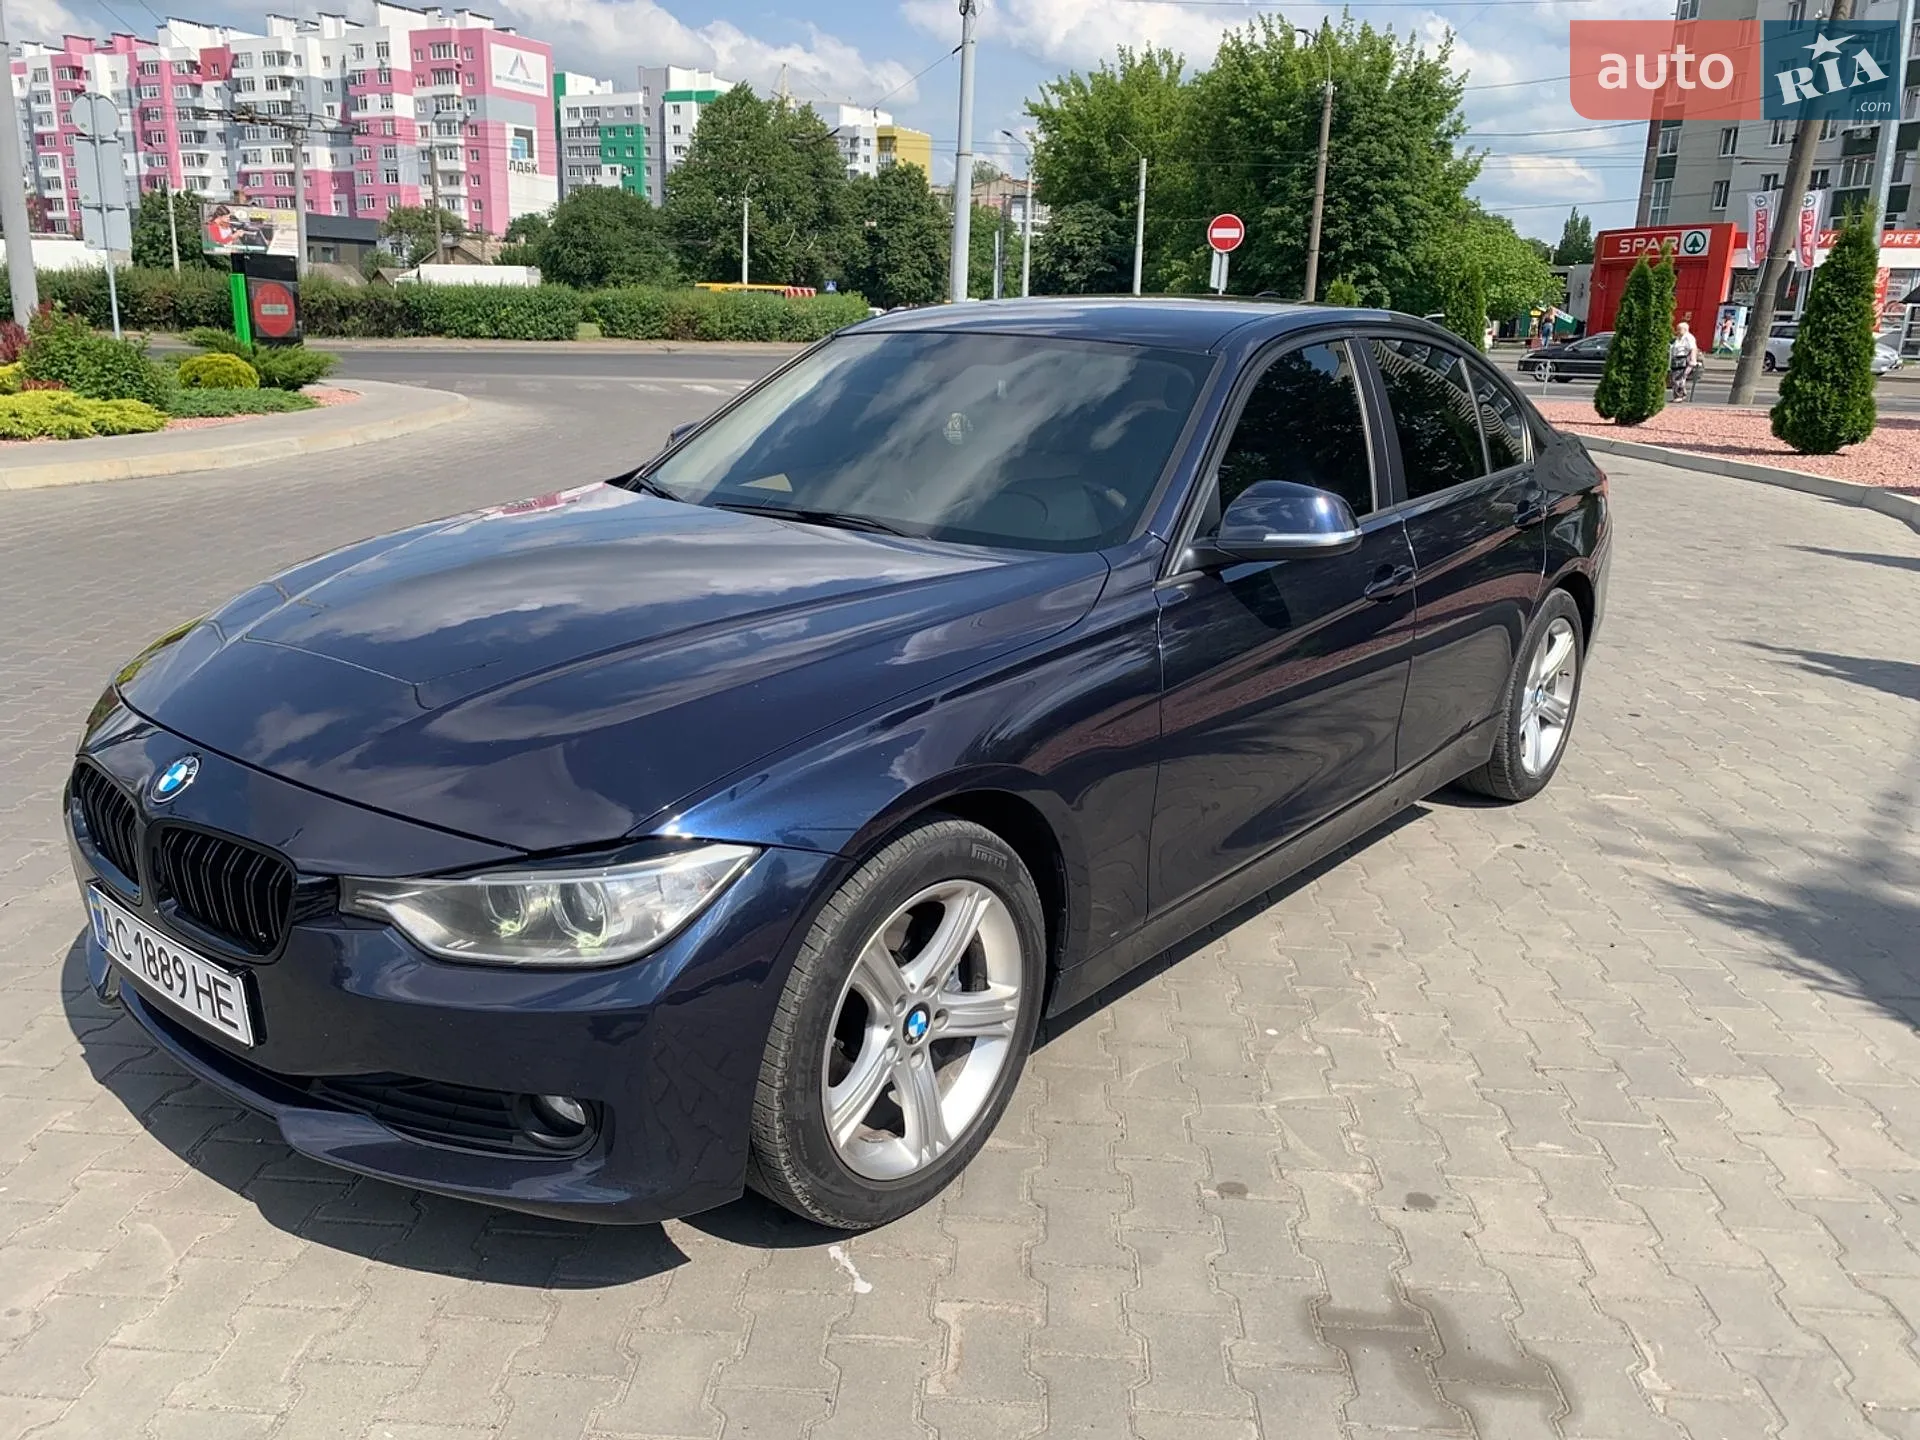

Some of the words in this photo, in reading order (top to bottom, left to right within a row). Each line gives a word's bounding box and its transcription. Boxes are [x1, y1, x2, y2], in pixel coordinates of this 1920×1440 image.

[1618, 235, 1679, 254] SPAR
[103, 906, 132, 961] AC
[134, 929, 188, 999] 1889
[192, 964, 239, 1031] HE
